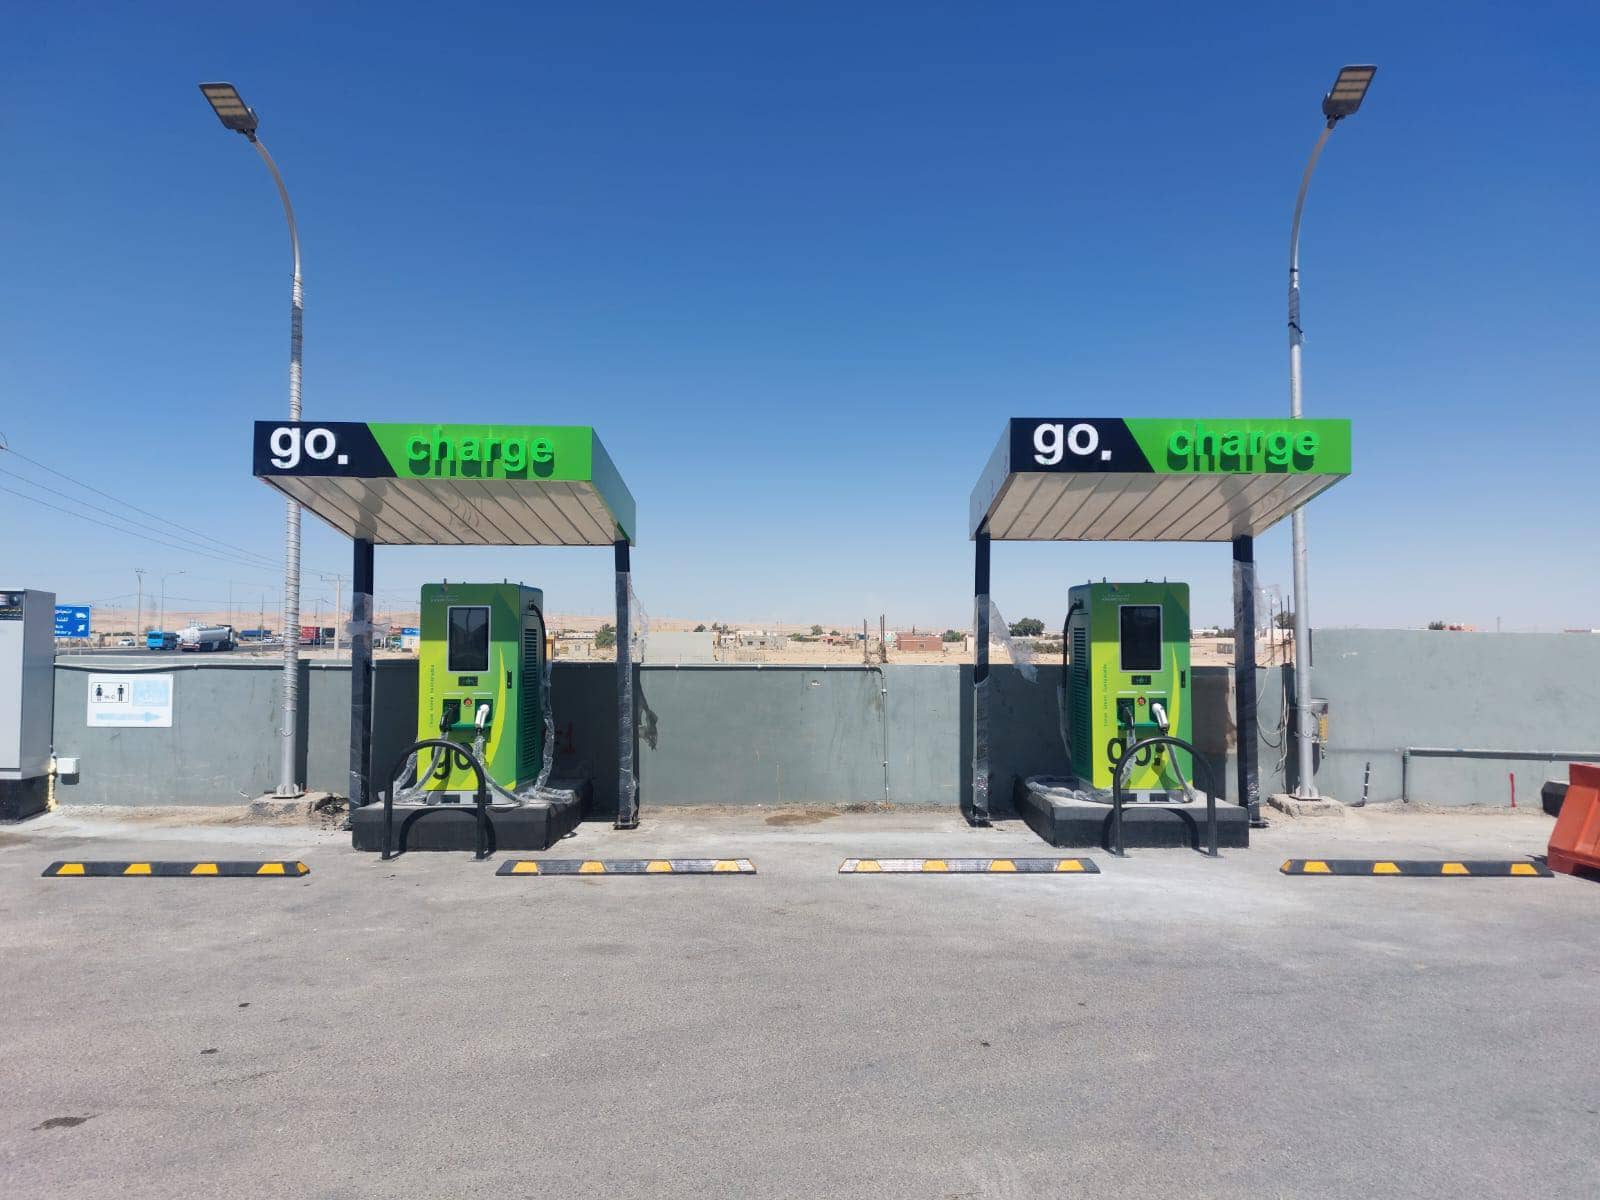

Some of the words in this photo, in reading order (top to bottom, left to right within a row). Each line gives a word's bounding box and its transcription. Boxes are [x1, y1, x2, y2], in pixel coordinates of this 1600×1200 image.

[270, 426, 349, 469] go.
[405, 427, 554, 472] charge
[1032, 422, 1112, 465] go.
[1168, 423, 1321, 465] charge
